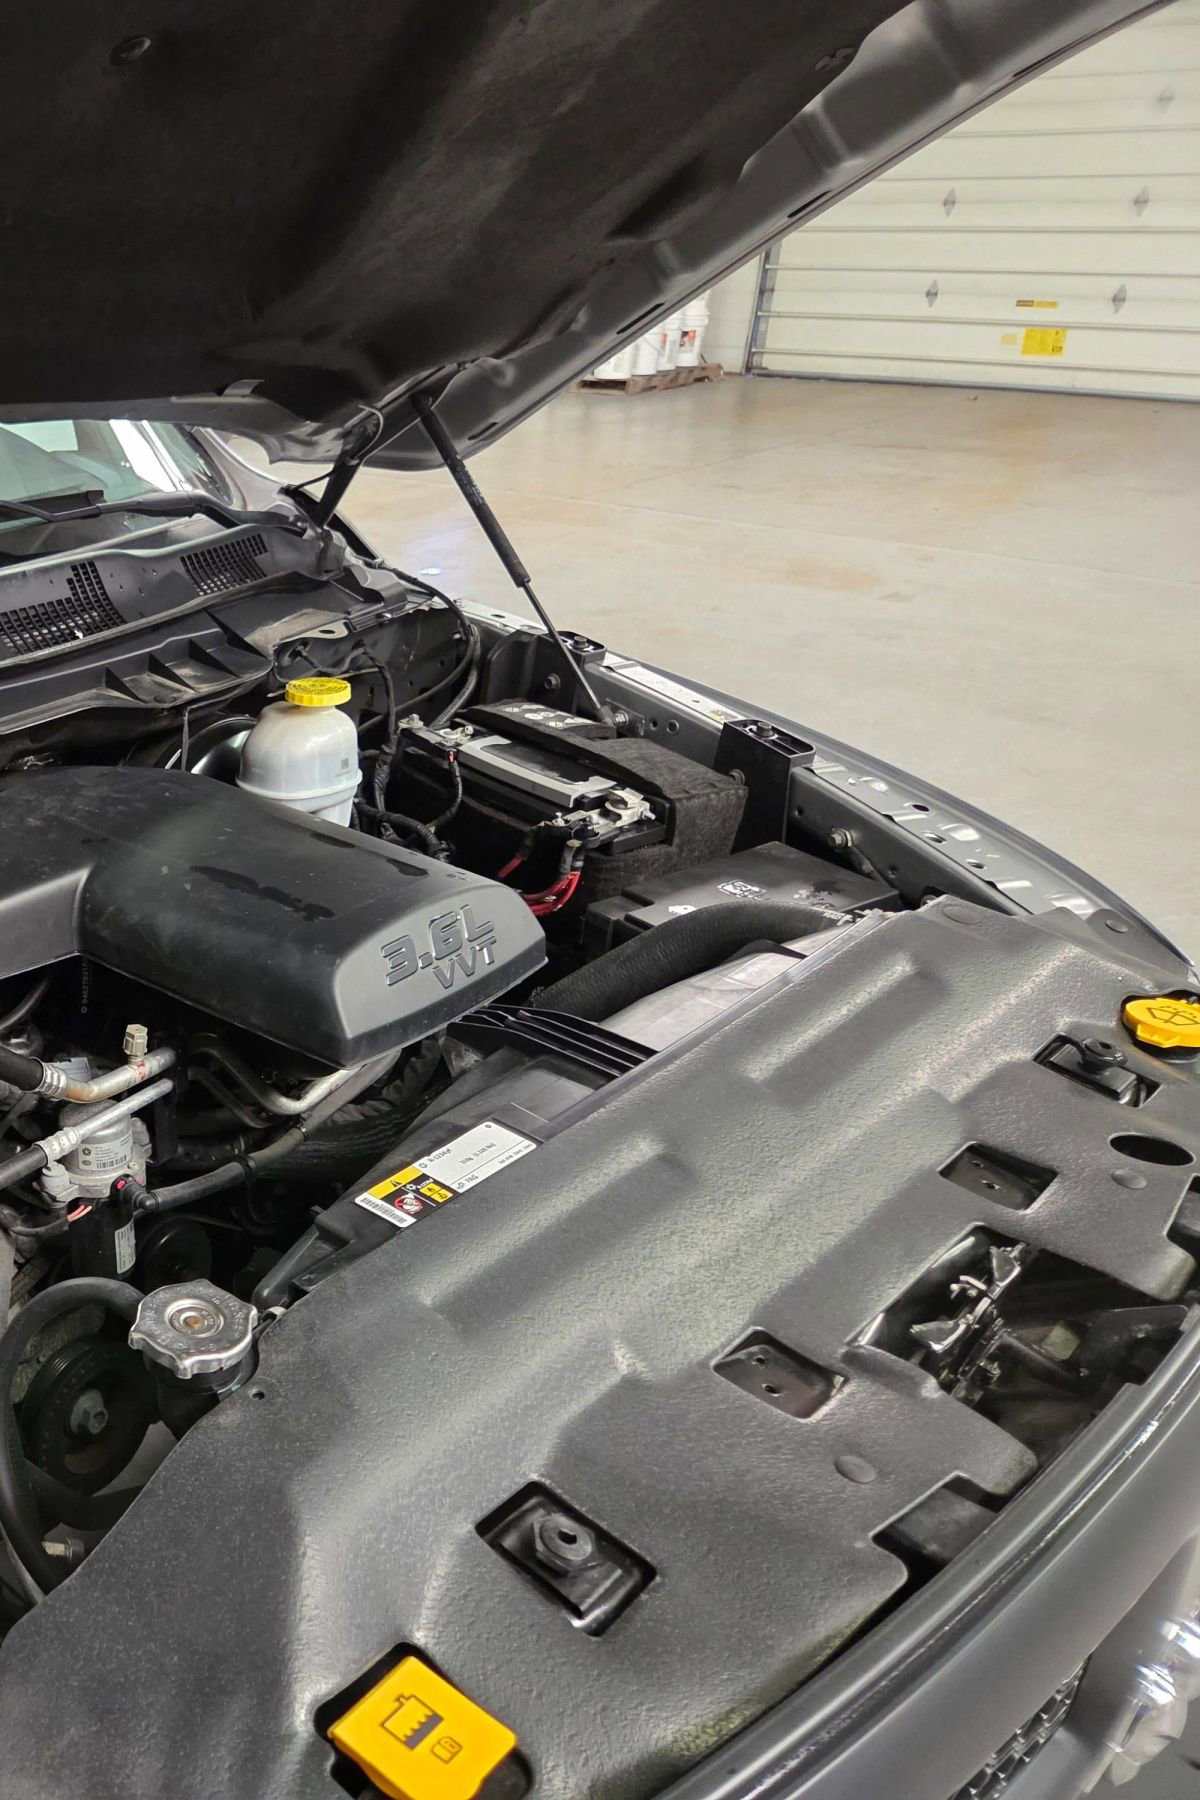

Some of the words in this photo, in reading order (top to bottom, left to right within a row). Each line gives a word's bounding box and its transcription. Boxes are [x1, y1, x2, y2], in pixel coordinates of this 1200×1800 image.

[380, 904, 495, 986] 3.6L
[432, 935, 497, 989] VVT
[464, 1174, 479, 1183] PAG
